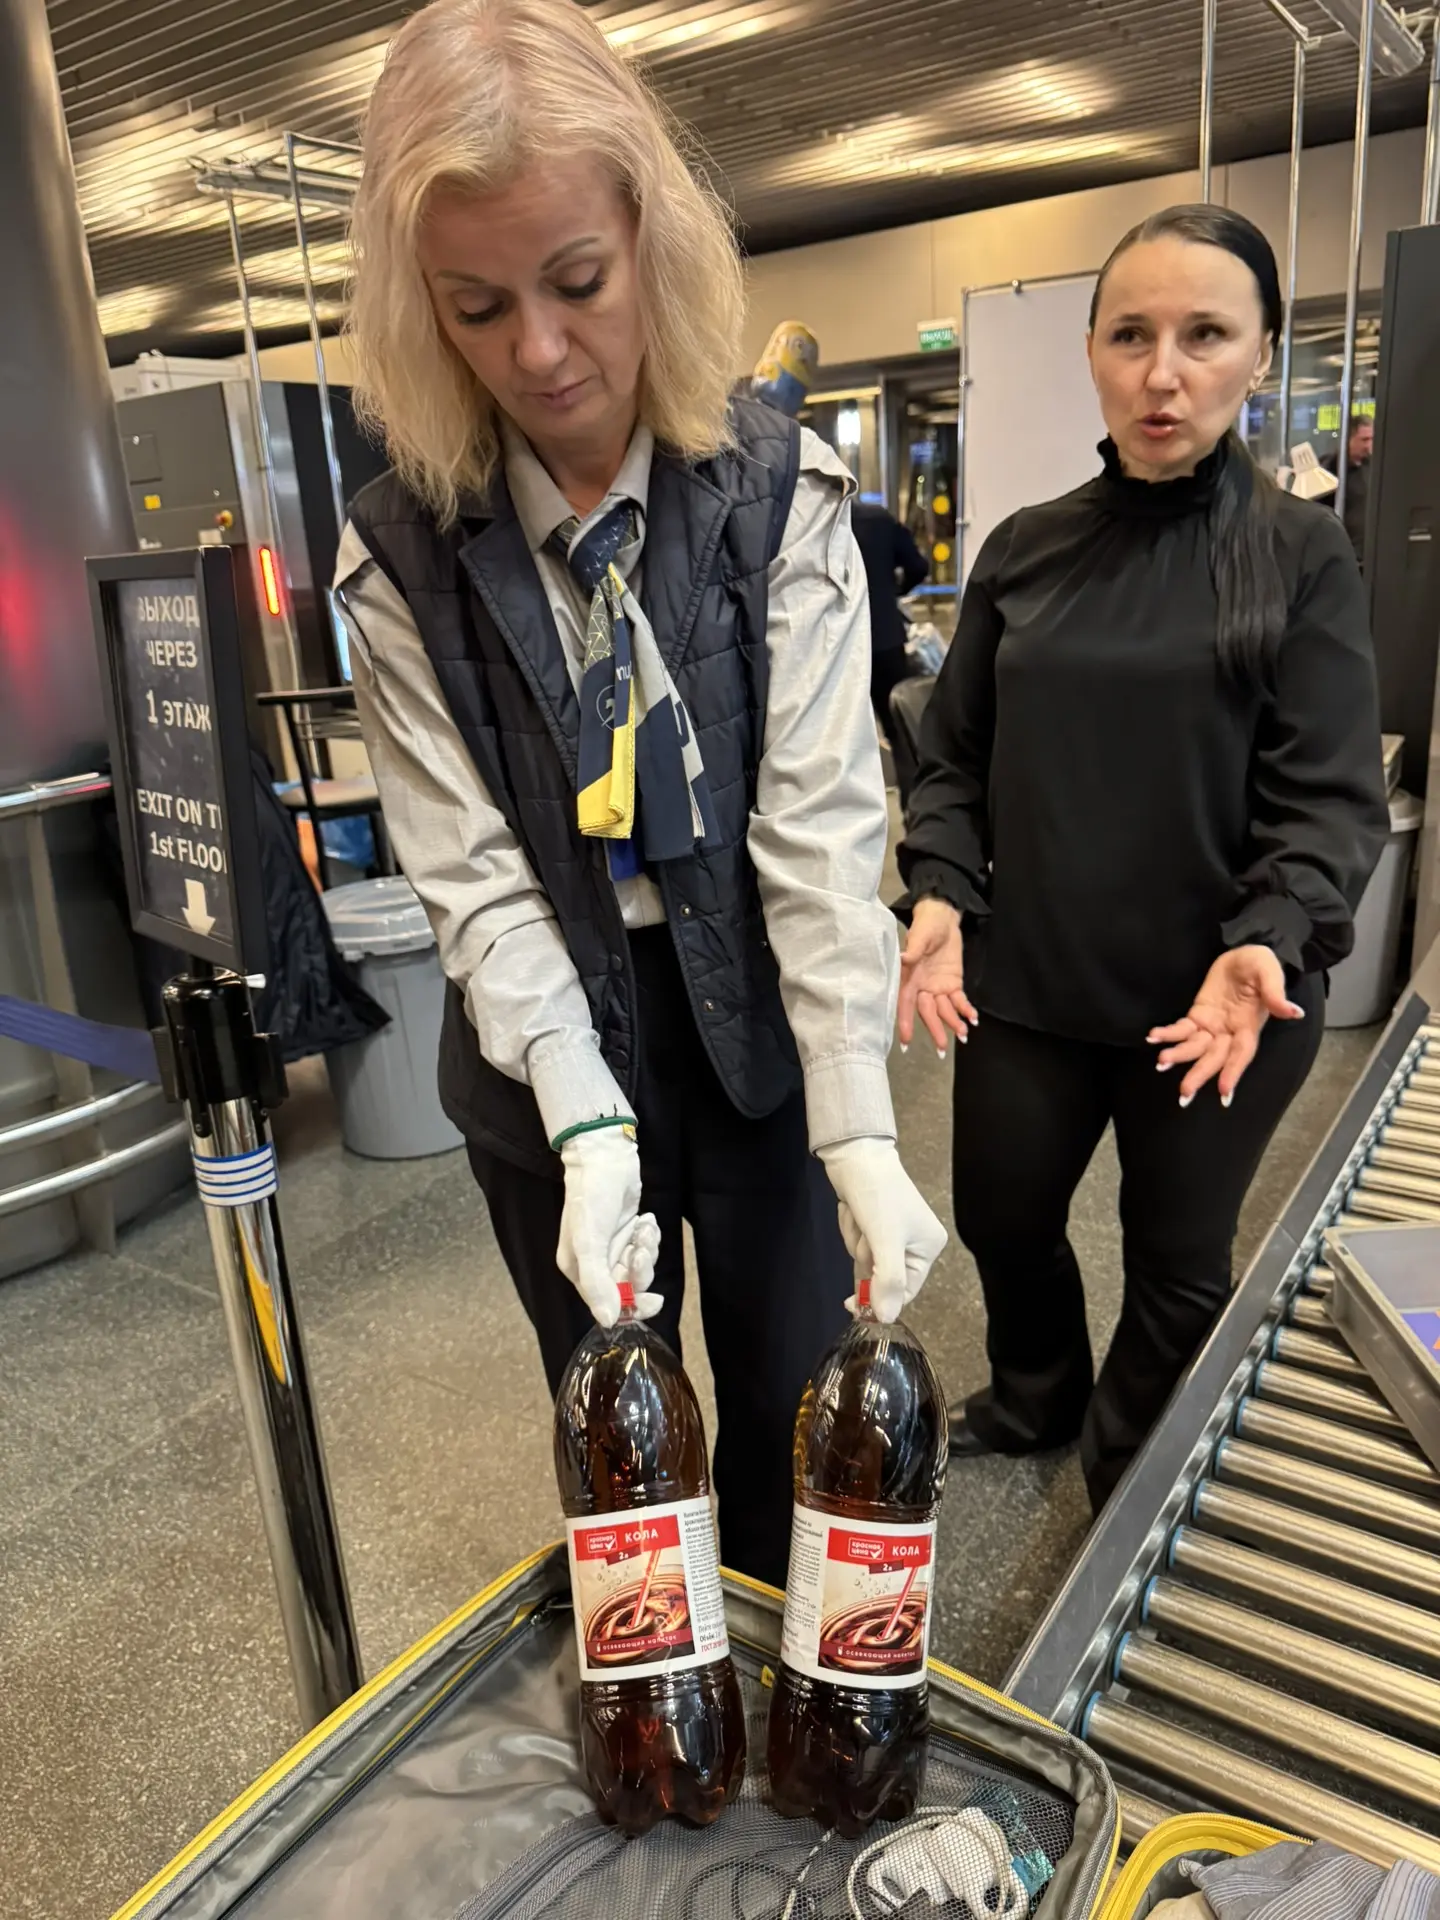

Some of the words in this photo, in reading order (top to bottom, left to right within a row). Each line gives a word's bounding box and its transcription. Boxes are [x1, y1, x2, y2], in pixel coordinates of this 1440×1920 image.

[145, 640, 198, 668] ЧЕРЕЗ
[145, 689, 158, 724] 1
[162, 700, 212, 731] ЭТАЖ
[136, 788, 173, 819] EXIT
[175, 797, 203, 826] ON
[205, 802, 223, 831] T
[149, 831, 176, 860] 1st
[177, 838, 228, 874] FLOO
[624, 1528, 659, 1544] КОЛА
[892, 1545, 920, 1556] КОЛА
